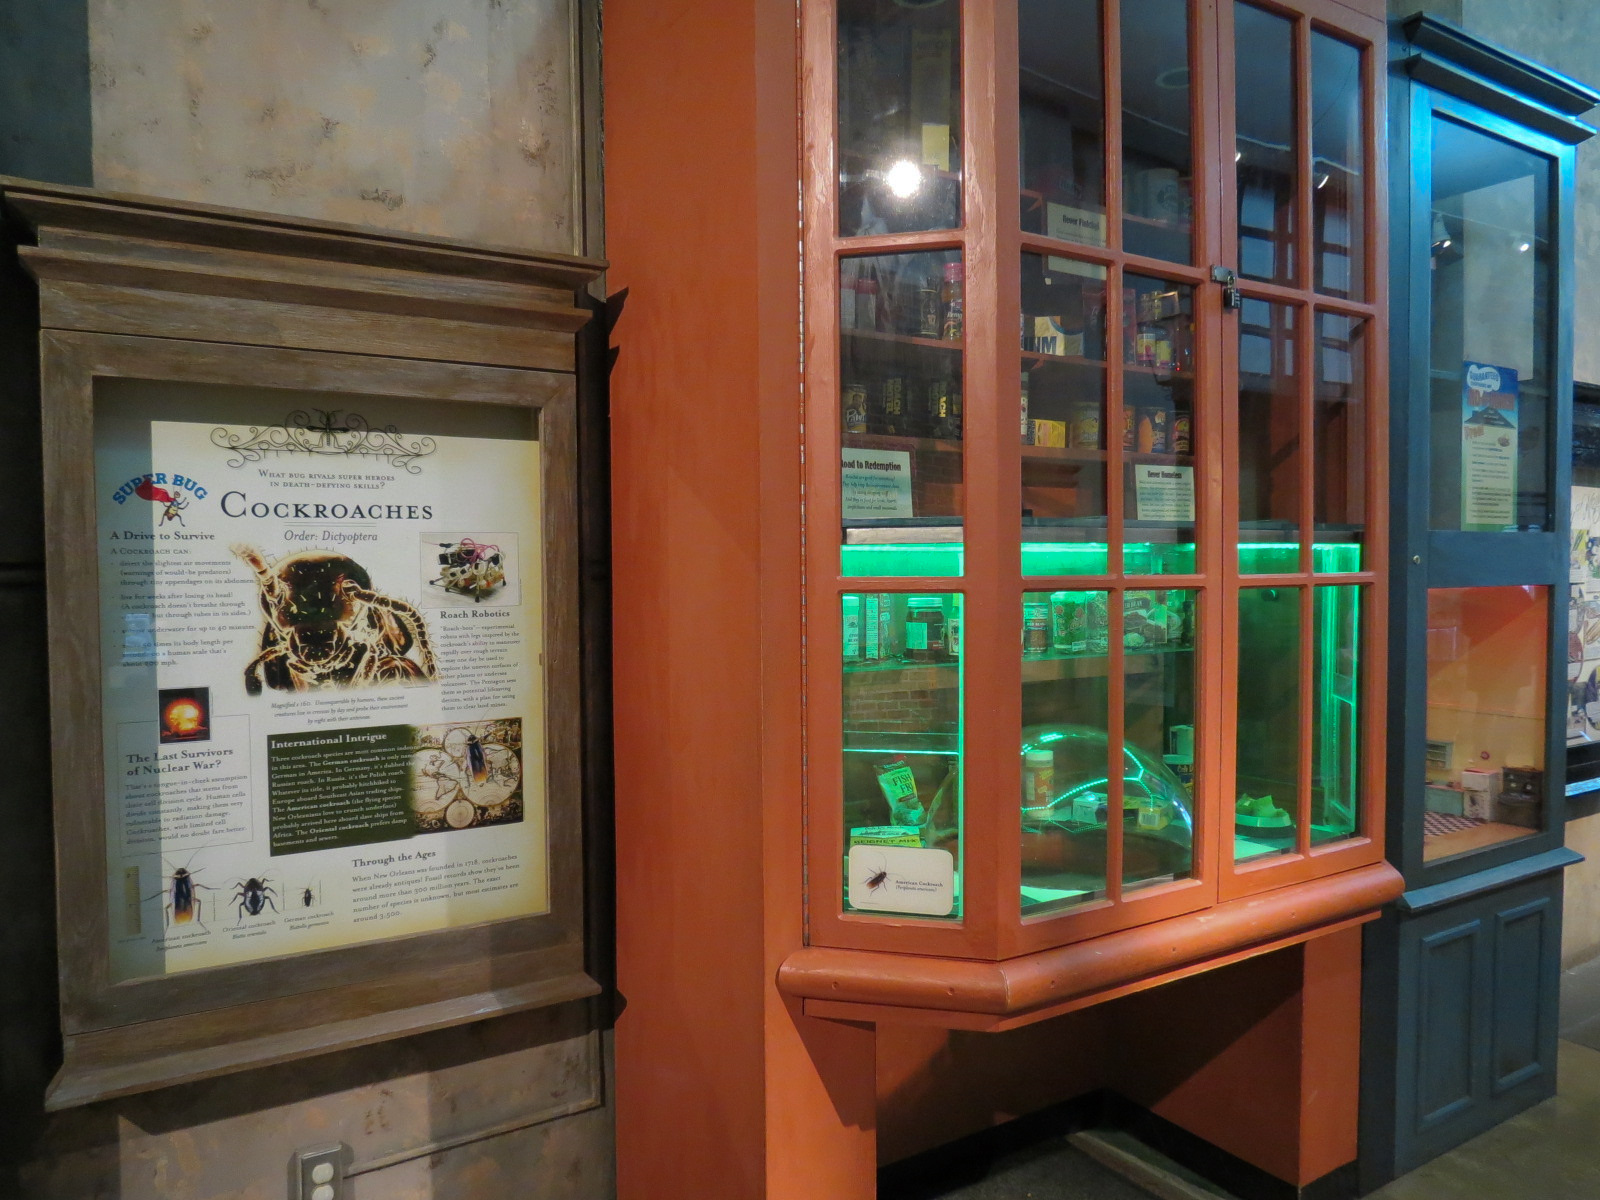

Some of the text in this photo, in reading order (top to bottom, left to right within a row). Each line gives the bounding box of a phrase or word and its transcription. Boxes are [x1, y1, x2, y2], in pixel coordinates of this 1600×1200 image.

[857, 460, 863, 469] to
[865, 461, 901, 472] Redemption
[258, 469, 285, 478] WHAT
[113, 473, 208, 505] SUPER BUG
[221, 491, 433, 520] COCKROACHES
[110, 531, 120, 540] A
[124, 531, 155, 540] Drive
[174, 531, 215, 540] Survive
[284, 530, 378, 544] Order: Dictyoptera
[440, 610, 510, 619] Roach Robotics
[271, 733, 387, 749] International Intrigue
[127, 749, 234, 763] The Last Survivors
[291, 753, 322, 761] cockroach
[323, 759, 348, 767] German
[350, 756, 380, 764] cockroach
[127, 760, 222, 776] of Nuclear War?
[892, 773, 912, 786] FISH
[286, 804, 318, 812] American
[320, 800, 350, 809] cockroach
[310, 826, 337, 834] Oriental
[339, 822, 369, 831] cockroach
[352, 850, 436, 868] Through the Ages
[352, 874, 371, 882] When
[389, 869, 415, 877] Orleans
[429, 863, 455, 872] founded
[465, 859, 480, 868] 1718,
[482, 854, 518, 864] cockroaches
[370, 882, 392, 892] already
[394, 877, 423, 888] antiques!
[425, 874, 442, 882] Fossil
[444, 871, 466, 880] records
[468, 868, 482, 876] show
[353, 895, 377, 903] around
[379, 891, 396, 899] more
[415, 886, 427, 896] 300
[429, 883, 453, 892] million
[454, 881, 472, 890] years.
[353, 904, 379, 913] number
[390, 898, 412, 908] species
[421, 893, 452, 903] unknown,
[353, 914, 378, 923] around
